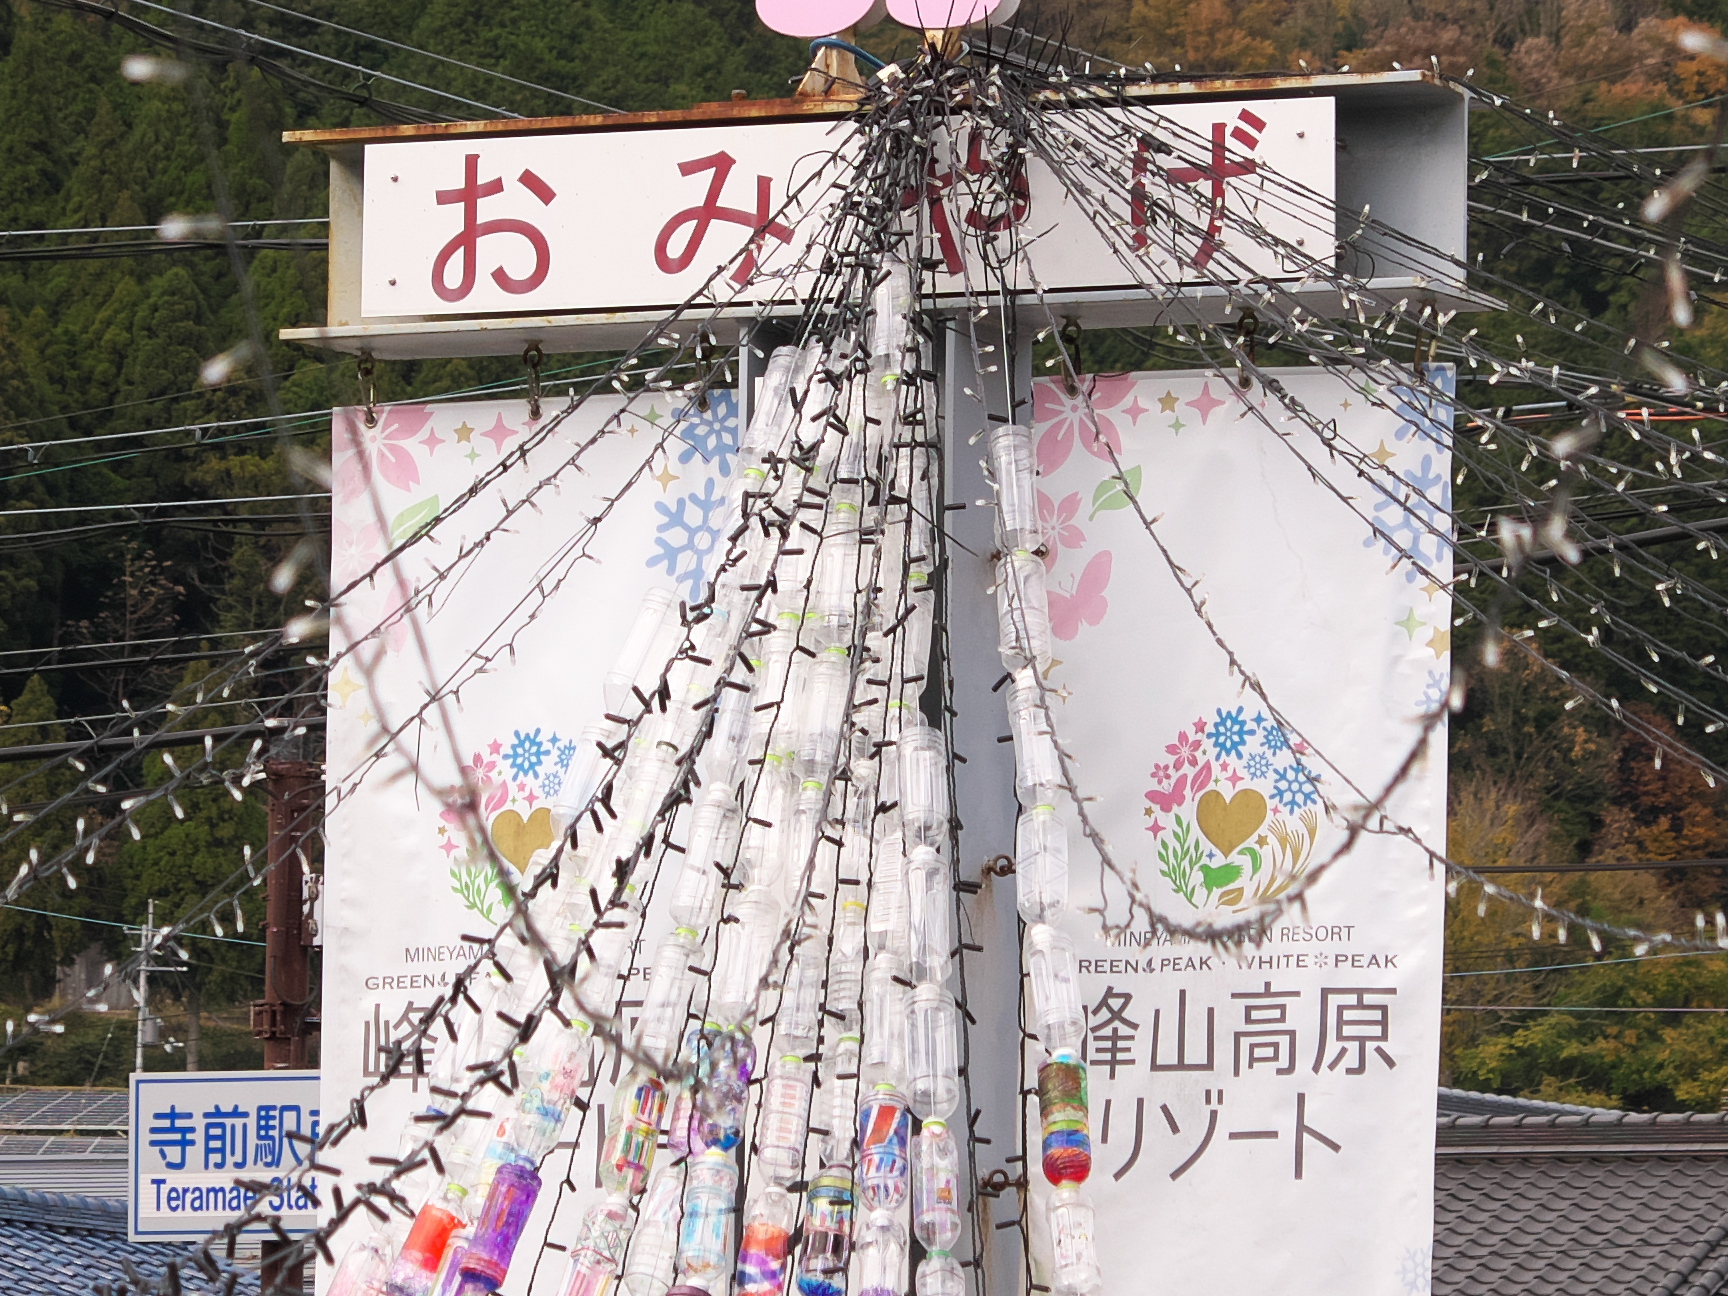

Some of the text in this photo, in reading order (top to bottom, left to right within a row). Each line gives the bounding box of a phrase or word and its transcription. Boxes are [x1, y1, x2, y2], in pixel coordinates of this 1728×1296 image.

[1105, 929, 1208, 947] MINEYA
[1281, 925, 1356, 943] RESORT
[404, 944, 485, 963] MINEYAM
[1078, 953, 1399, 974] REEN PEAK WHITE PEAK
[365, 973, 435, 991] GREEN
[1079, 980, 1399, 1081] 峰山高原
[1100, 1088, 1343, 1183] リゾート
